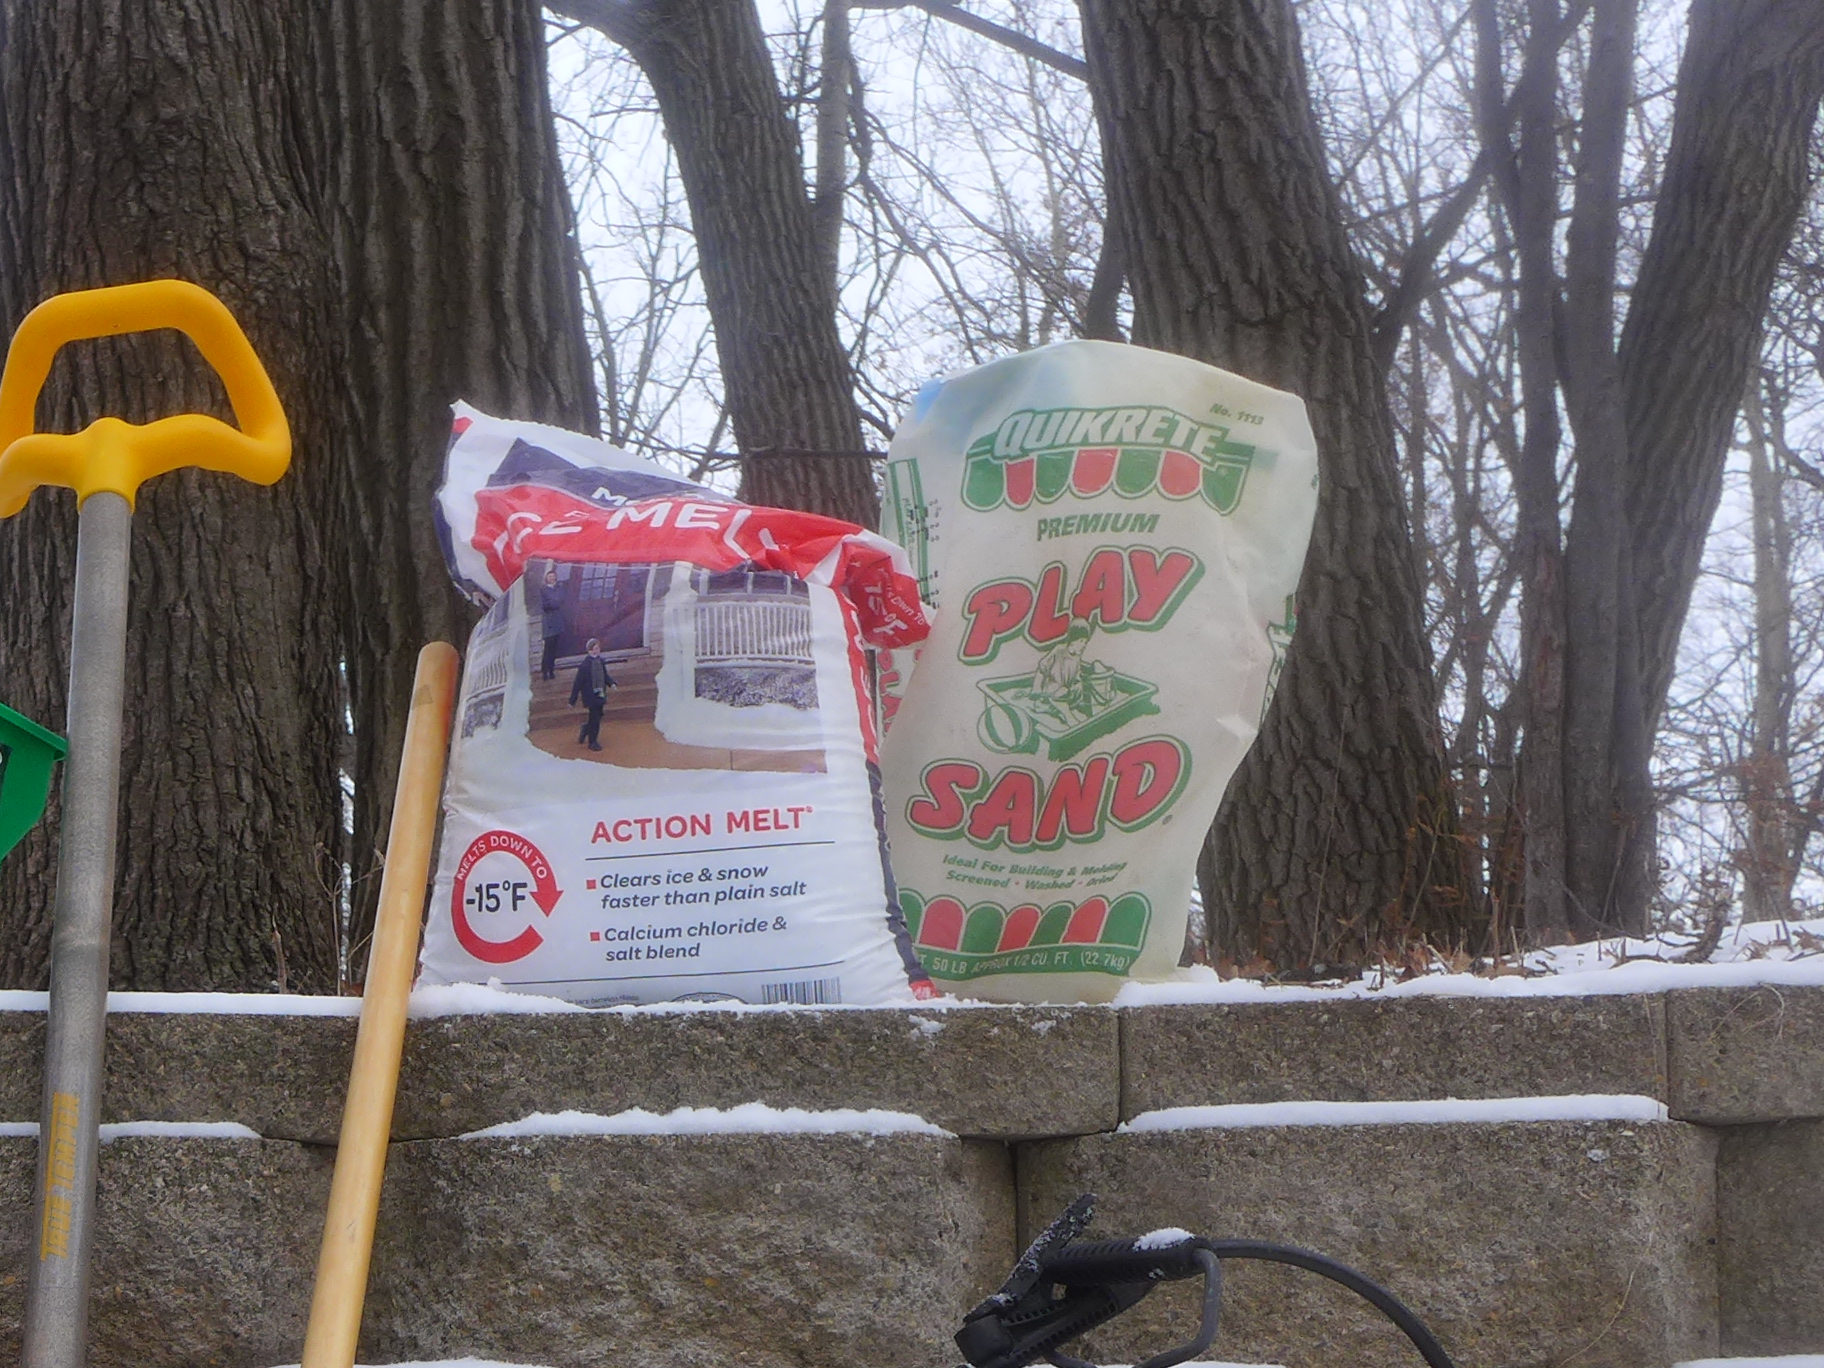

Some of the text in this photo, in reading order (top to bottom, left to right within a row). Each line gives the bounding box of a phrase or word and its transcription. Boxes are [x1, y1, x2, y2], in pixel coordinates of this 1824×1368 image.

[1209, 403, 1232, 417] No.
[993, 408, 1226, 462] QUIKRETE
[1036, 513, 1161, 542] PREMIUM
[959, 547, 1201, 663] PLAY
[907, 736, 1188, 850] SAND
[590, 813, 712, 844] ACTION
[456, 834, 549, 882] MELTS DOWN TO
[942, 854, 978, 870] Ideal
[981, 860, 1006, 874] For
[1009, 863, 1064, 880] Building
[600, 864, 769, 890] Clears ice & snow
[946, 869, 1011, 889] Screened
[1025, 878, 1076, 890] Washed
[465, 880, 528, 914] -15°F
[600, 881, 807, 911] faster than plain salt
[603, 916, 788, 943] Calcium chloride &
[605, 943, 701, 962] salt blend
[933, 957, 949, 972] 50
[951, 958, 967, 973] LB
